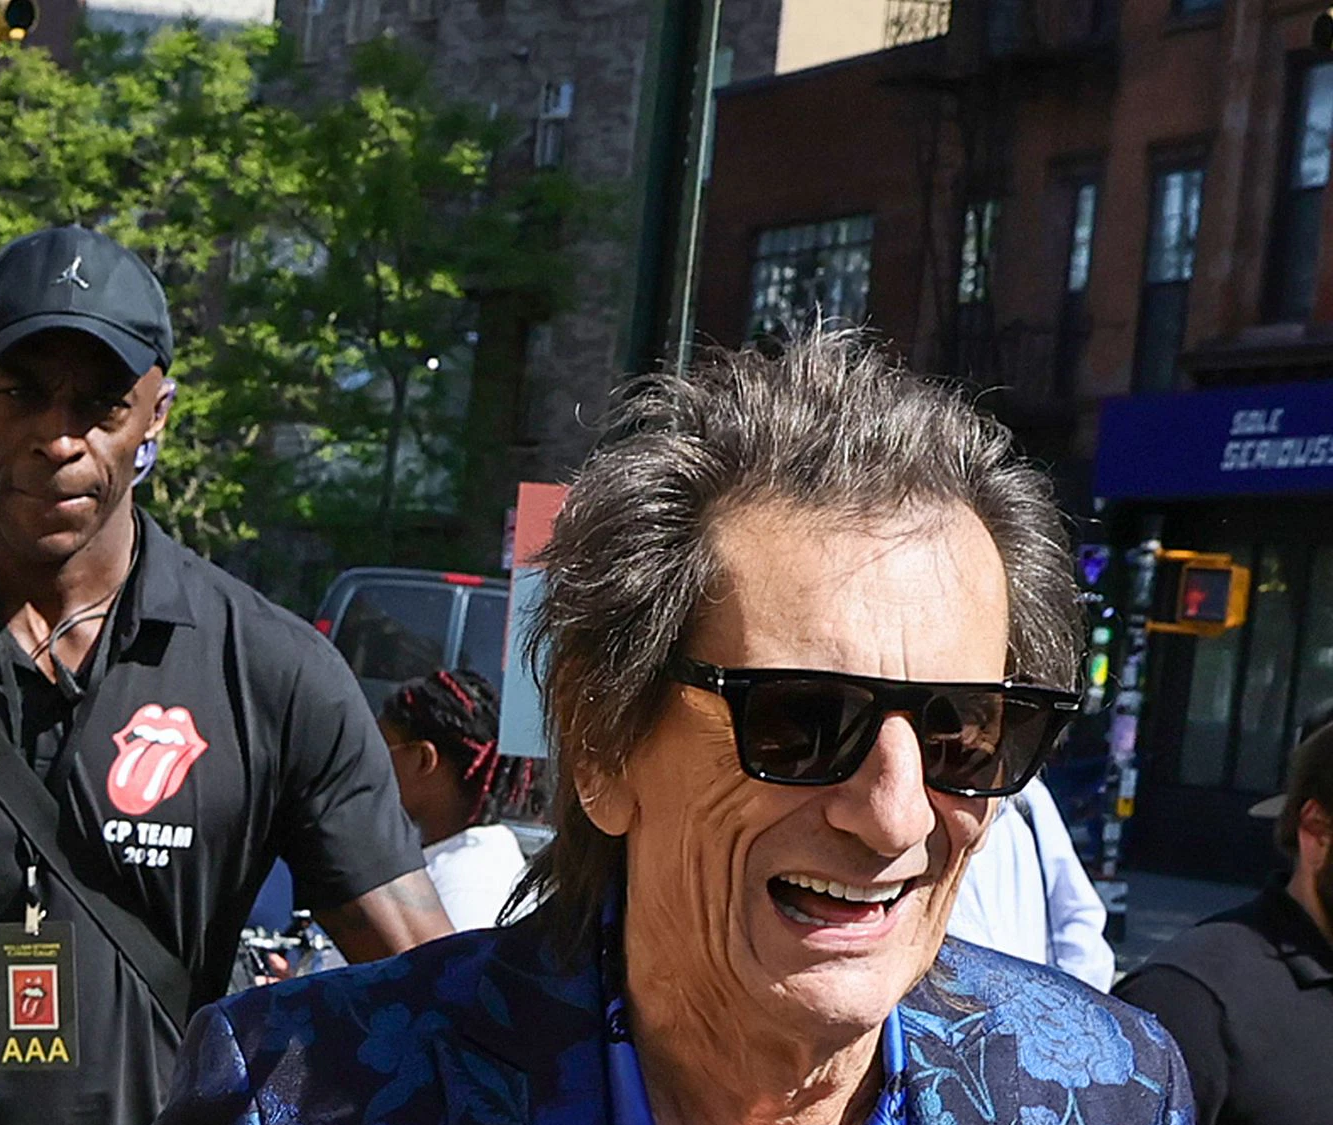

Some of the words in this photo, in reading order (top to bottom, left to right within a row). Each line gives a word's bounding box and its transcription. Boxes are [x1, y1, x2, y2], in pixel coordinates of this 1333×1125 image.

[103, 819, 133, 844] CP
[136, 822, 194, 848] TEAM
[122, 846, 170, 867] 2026
[1, 1036, 70, 1063] AAA
